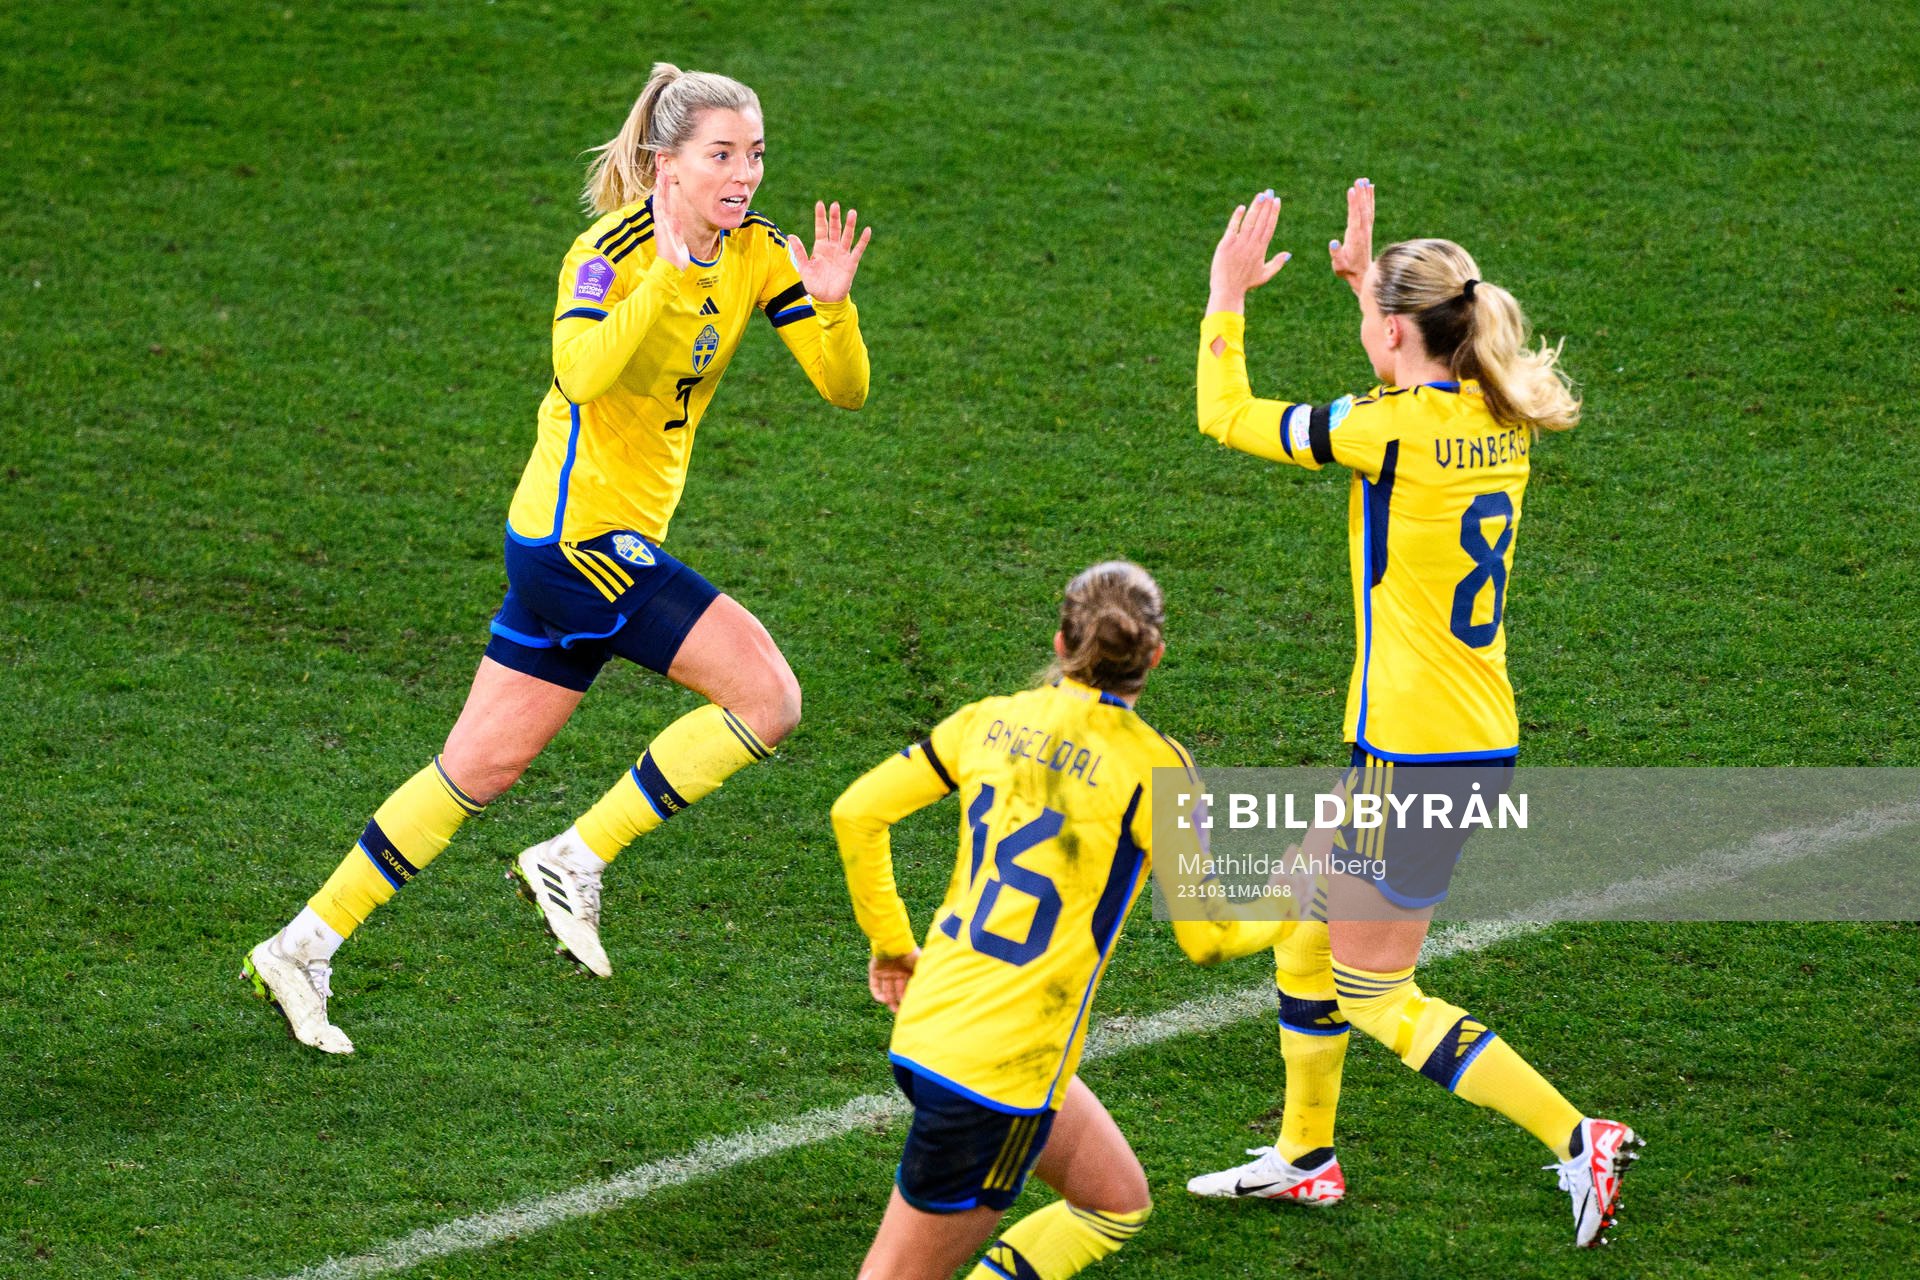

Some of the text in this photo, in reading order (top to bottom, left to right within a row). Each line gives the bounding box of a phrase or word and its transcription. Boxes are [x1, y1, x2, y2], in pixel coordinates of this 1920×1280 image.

[1435, 423, 1526, 469] VINBERG
[1450, 491, 1514, 649] 8
[982, 719, 1101, 787] ANGELDAL
[940, 782, 1066, 967] 16
